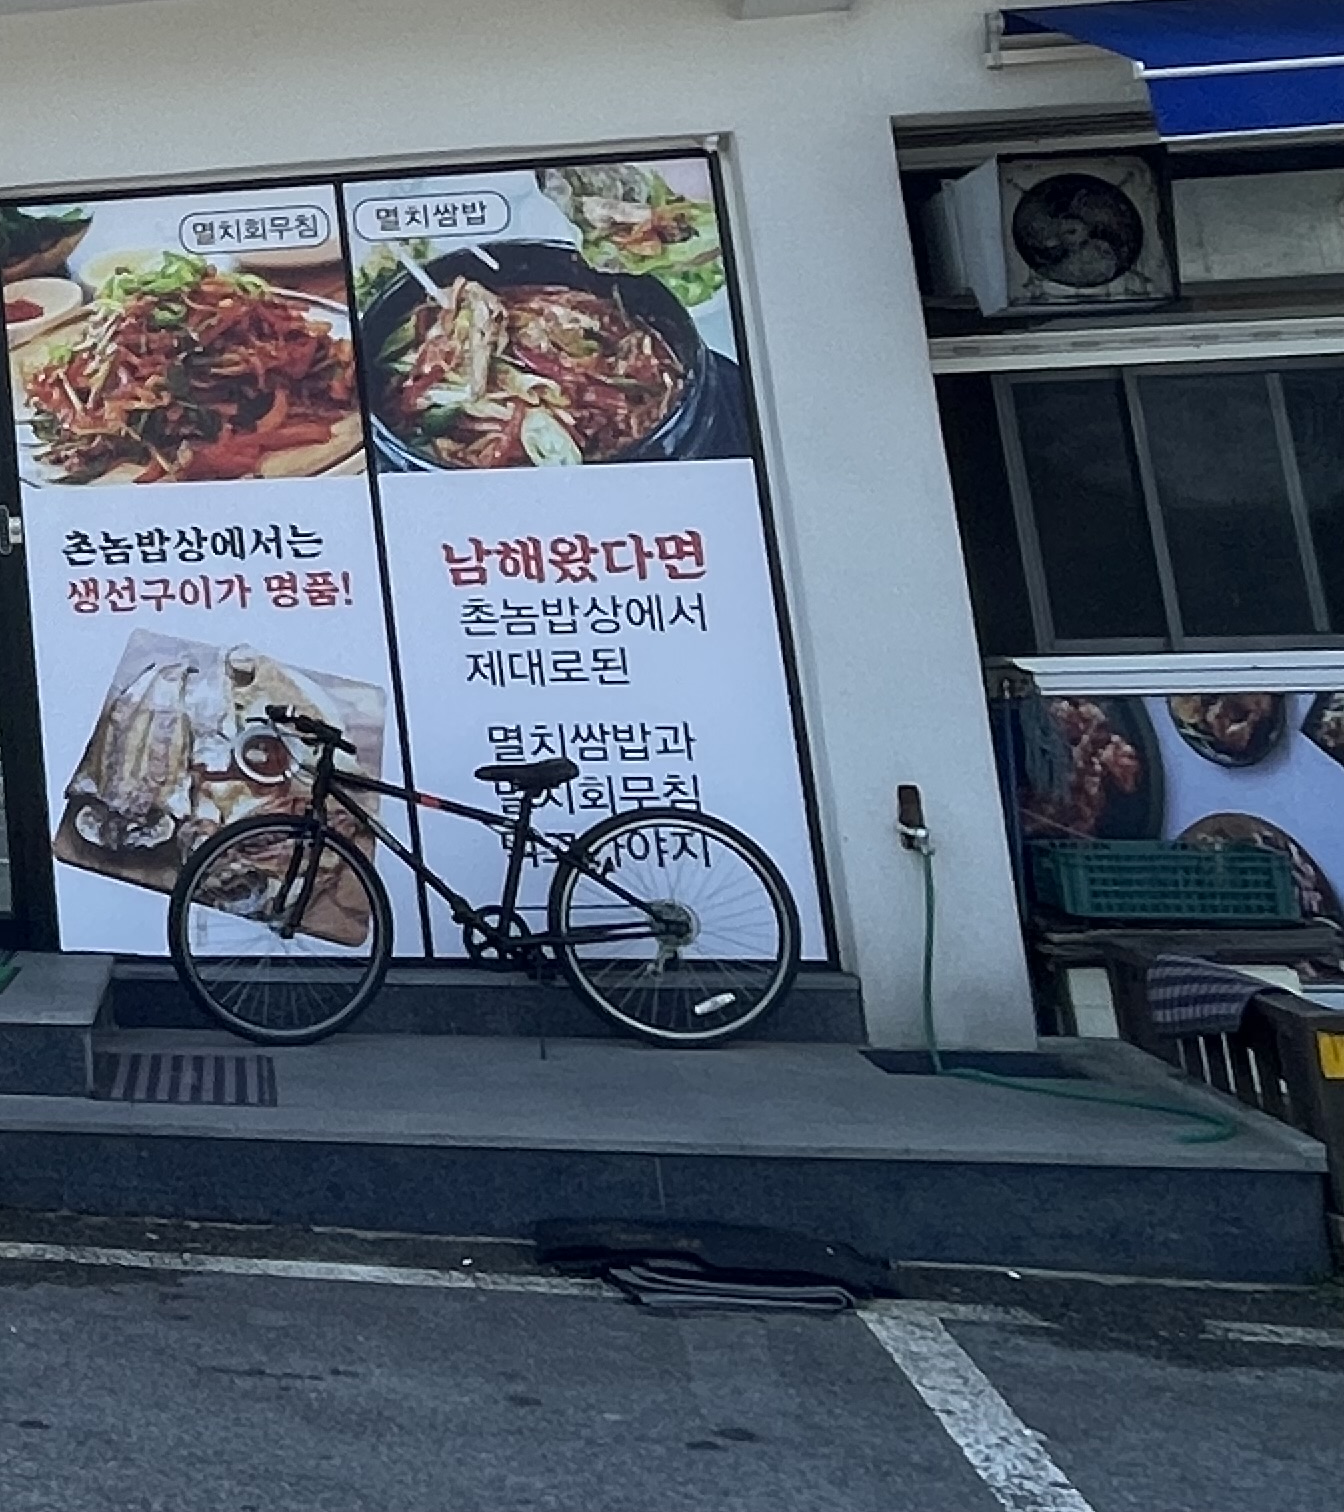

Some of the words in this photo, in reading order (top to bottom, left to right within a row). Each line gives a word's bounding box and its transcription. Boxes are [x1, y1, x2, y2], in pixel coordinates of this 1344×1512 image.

[191, 211, 319, 247] 멸치회무침
[374, 199, 488, 231] 멸치쌈밥
[62, 523, 323, 566] 촌놈밥상에서는
[441, 530, 706, 586] 남해왔다면
[67, 572, 252, 614] 생선구이가
[264, 570, 353, 608] 명품!
[460, 593, 708, 636] 촌놈밥상에서
[466, 646, 631, 687] 제대로된
[487, 721, 697, 762] 멸치쌈밥과
